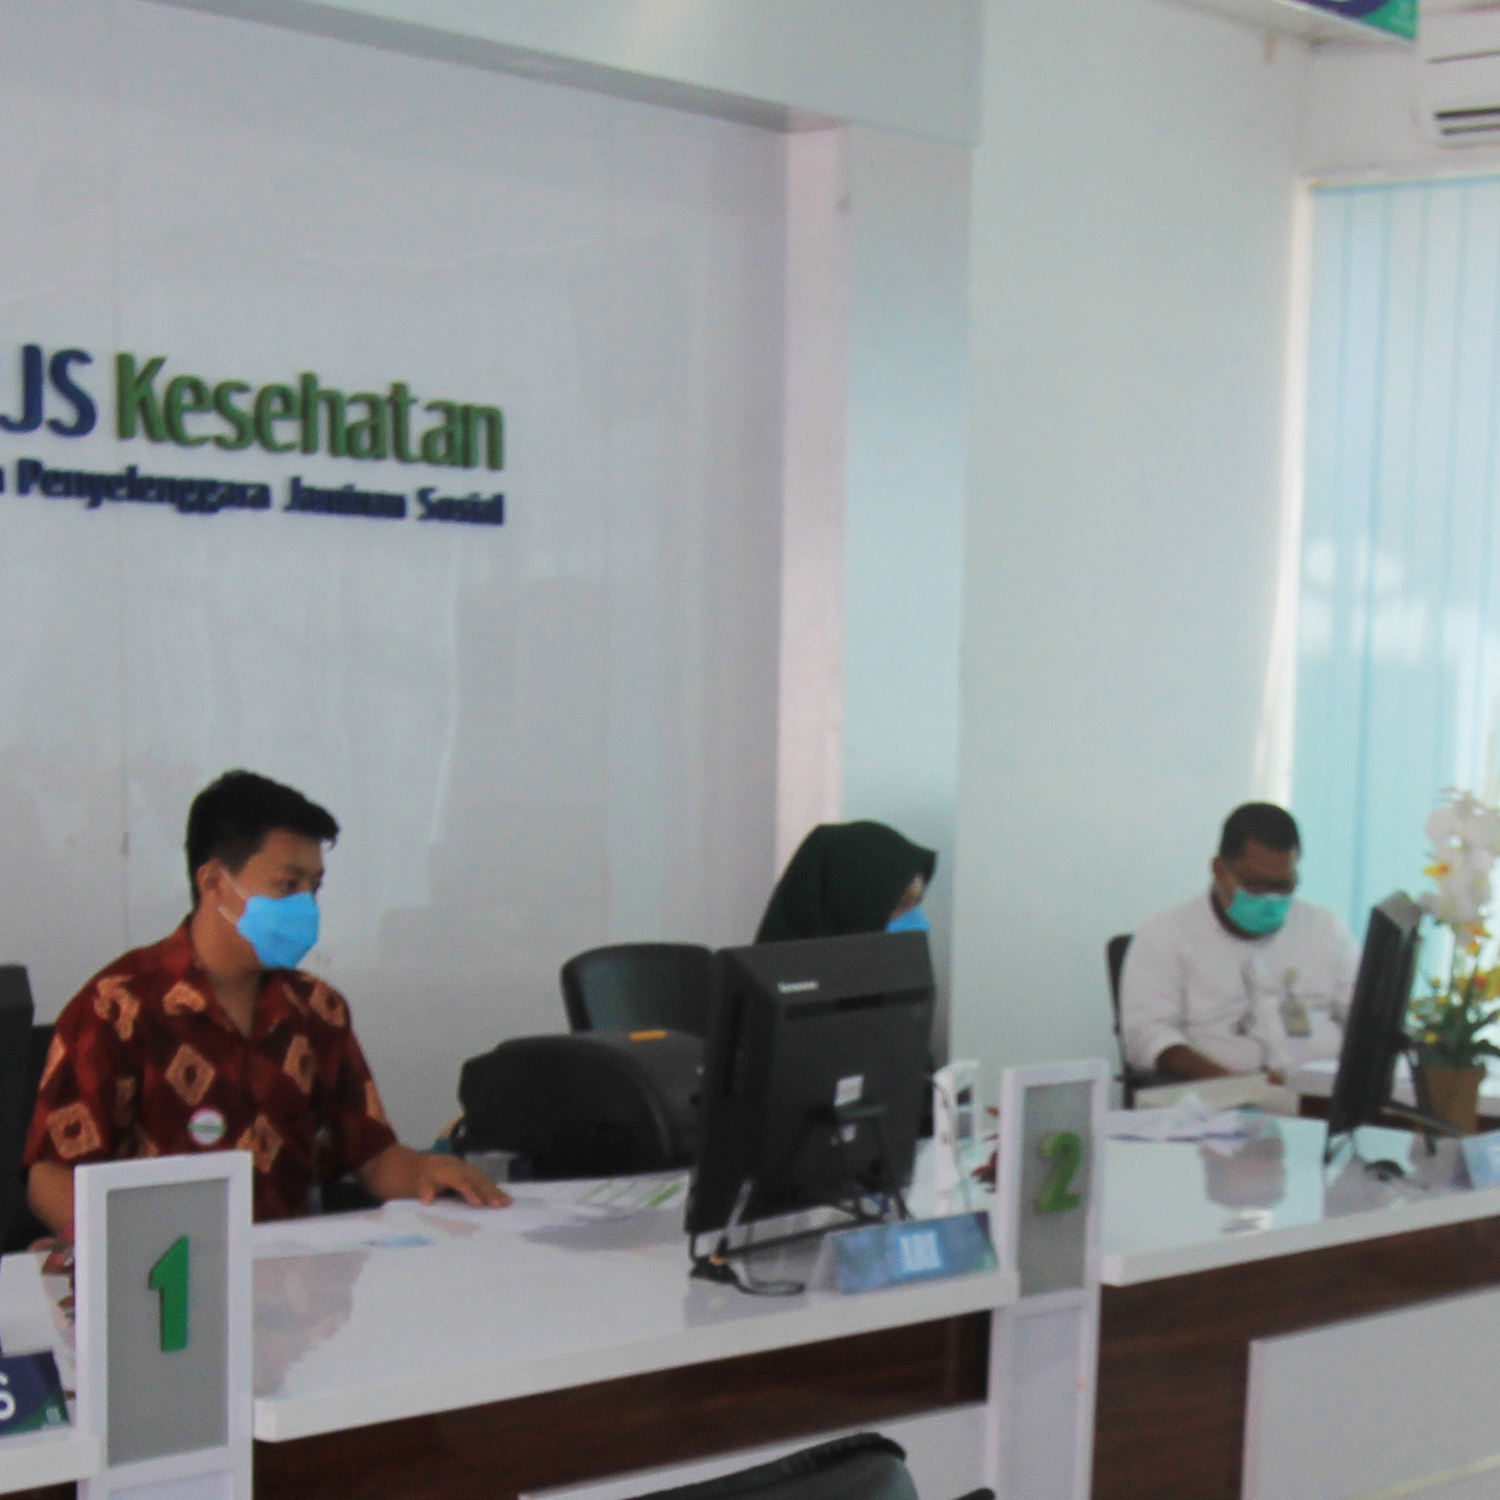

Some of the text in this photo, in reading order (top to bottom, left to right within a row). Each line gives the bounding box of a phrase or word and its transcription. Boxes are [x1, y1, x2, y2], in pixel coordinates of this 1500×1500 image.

[115, 351, 505, 471] Kesehatan
[17, 457, 271, 515] Penyelenggara
[1036, 1131, 1083, 1213] 2
[148, 1234, 190, 1352] 1
